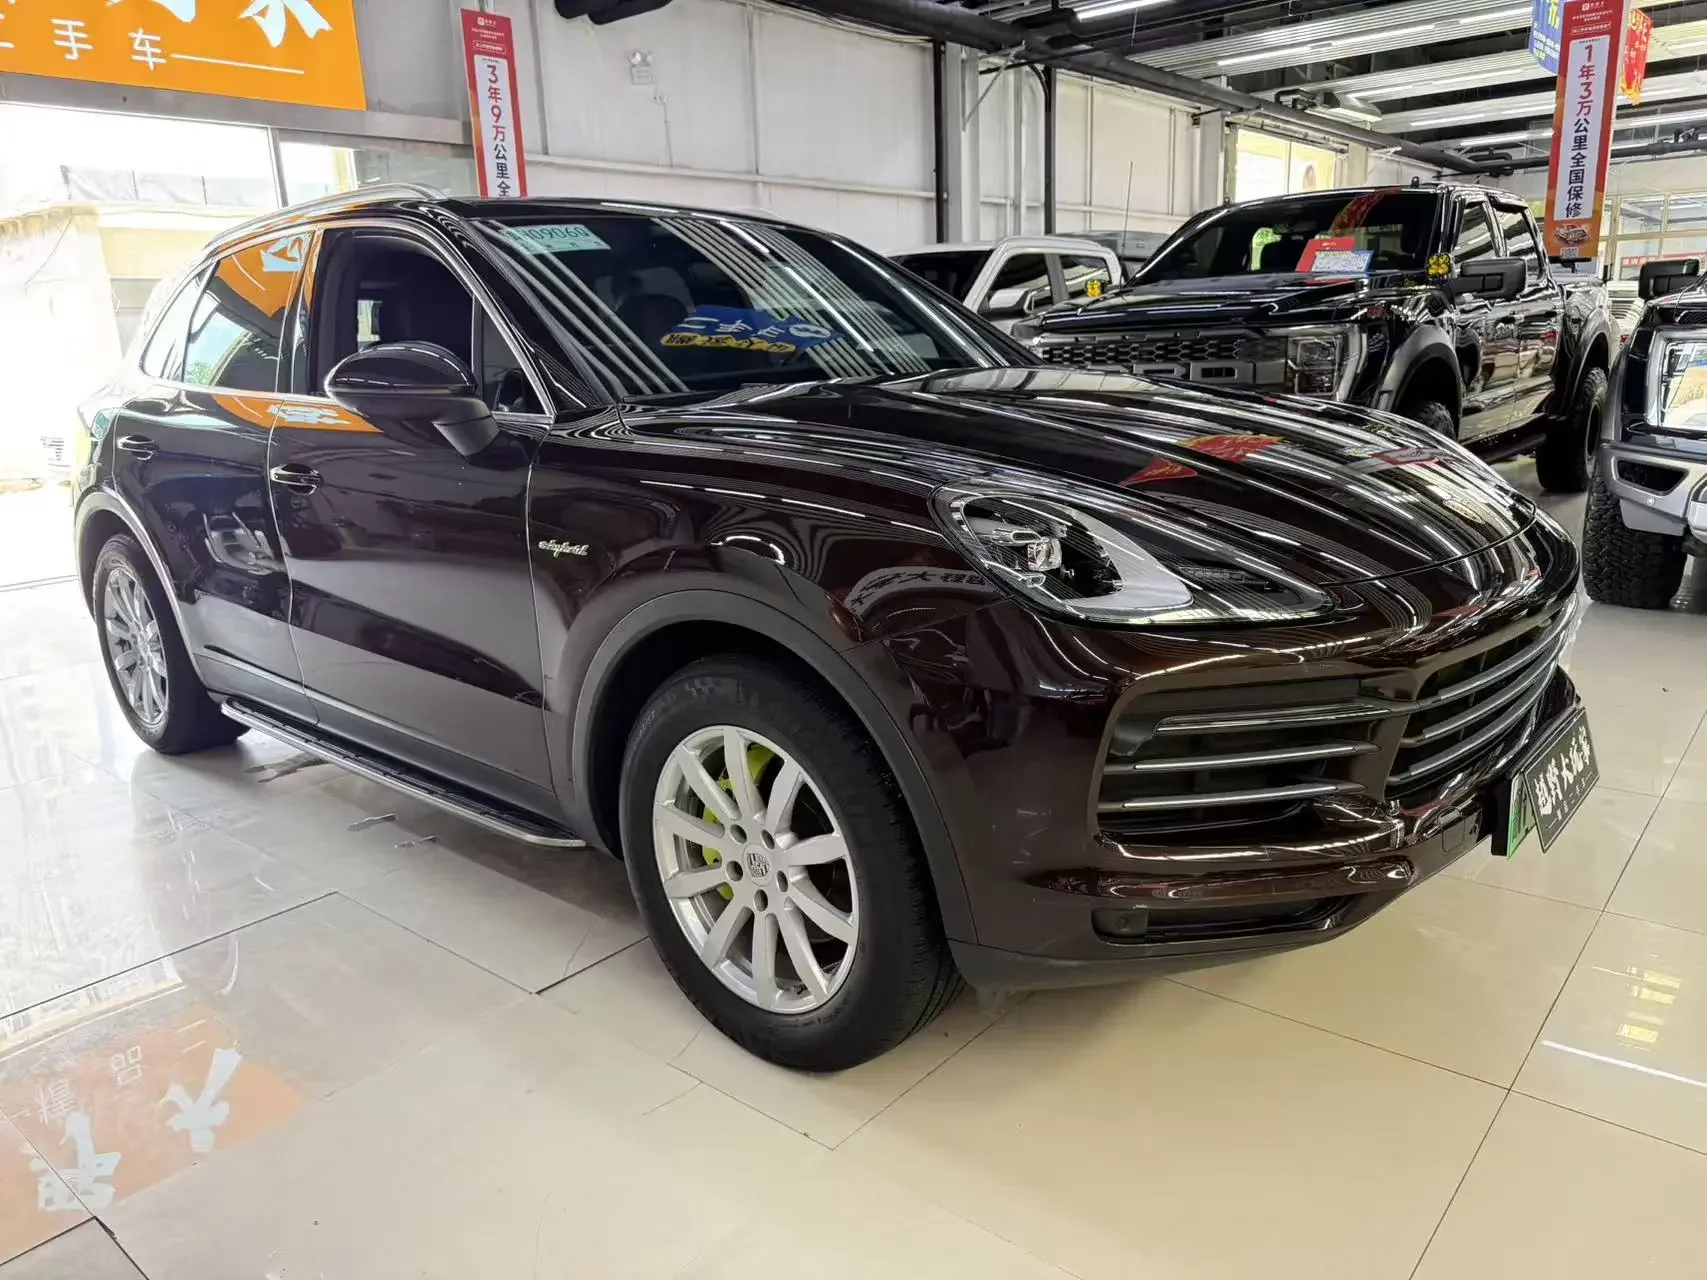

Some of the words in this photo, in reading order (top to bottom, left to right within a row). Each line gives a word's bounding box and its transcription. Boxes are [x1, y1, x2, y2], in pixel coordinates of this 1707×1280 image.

[487, 64, 511, 197] 3年9万公里全
[1565, 44, 1597, 219] 1年3万公里全国保修
